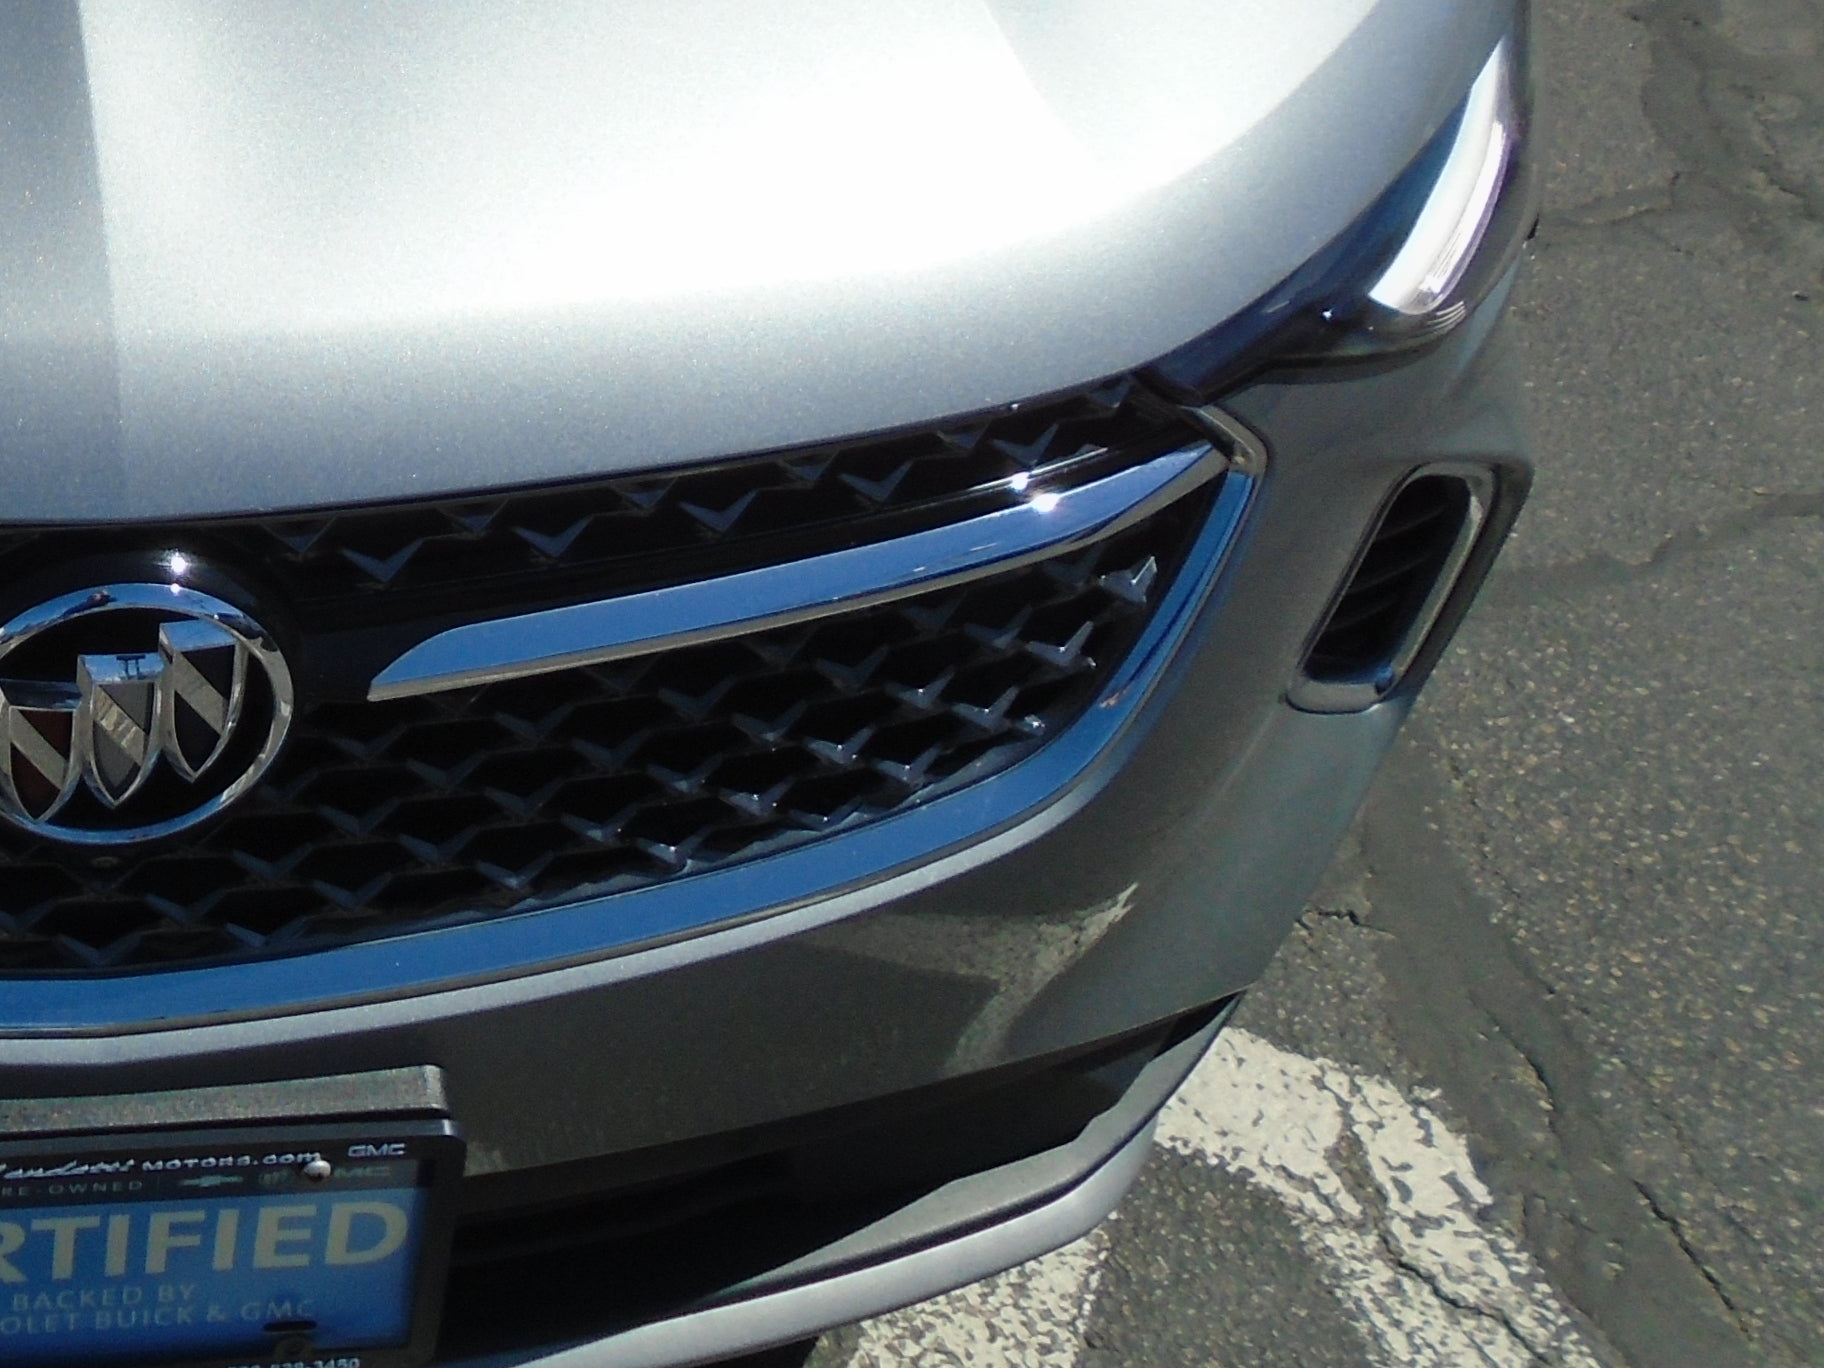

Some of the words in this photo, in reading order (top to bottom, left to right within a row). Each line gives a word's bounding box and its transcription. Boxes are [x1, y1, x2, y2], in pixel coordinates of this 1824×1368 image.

[347, 1143, 407, 1158] GMC
[12, 1285, 143, 1313] BACKED
[159, 1283, 198, 1303] BY
[94, 1305, 192, 1331] BUICK
[206, 1303, 226, 1323] &
[239, 1299, 314, 1321] GMC
